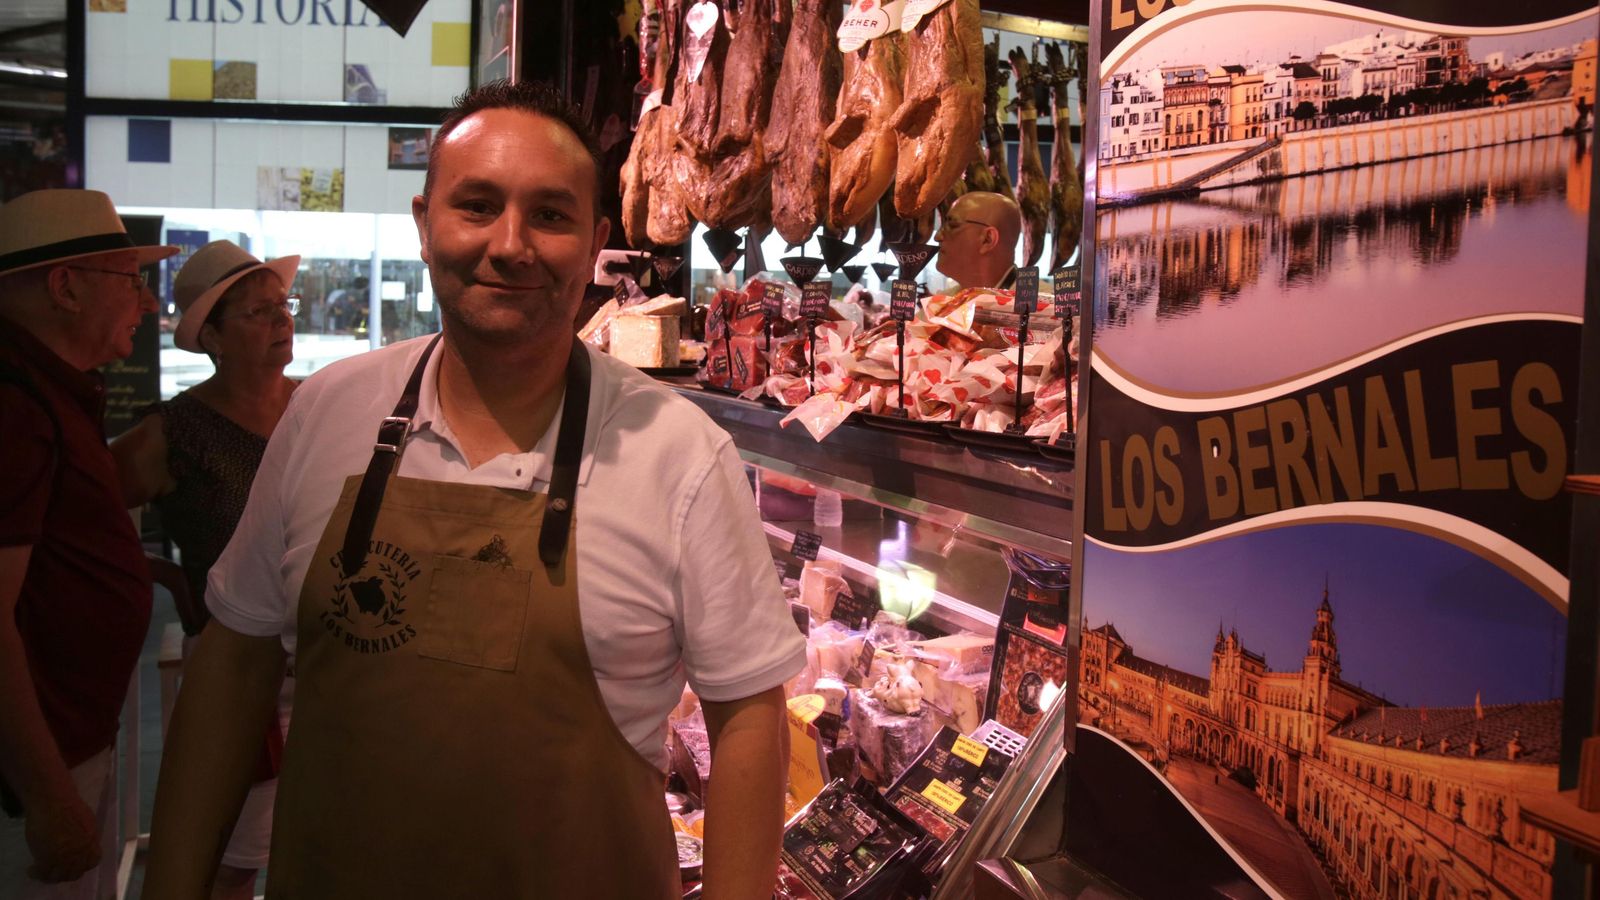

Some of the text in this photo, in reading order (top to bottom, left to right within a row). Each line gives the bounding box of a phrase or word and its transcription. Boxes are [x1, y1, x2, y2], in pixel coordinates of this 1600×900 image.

[1099, 360, 1568, 532] LOS BERNALES
[330, 540, 422, 581] CCUTERÍA
[320, 611, 417, 654] LOS BERNALES
